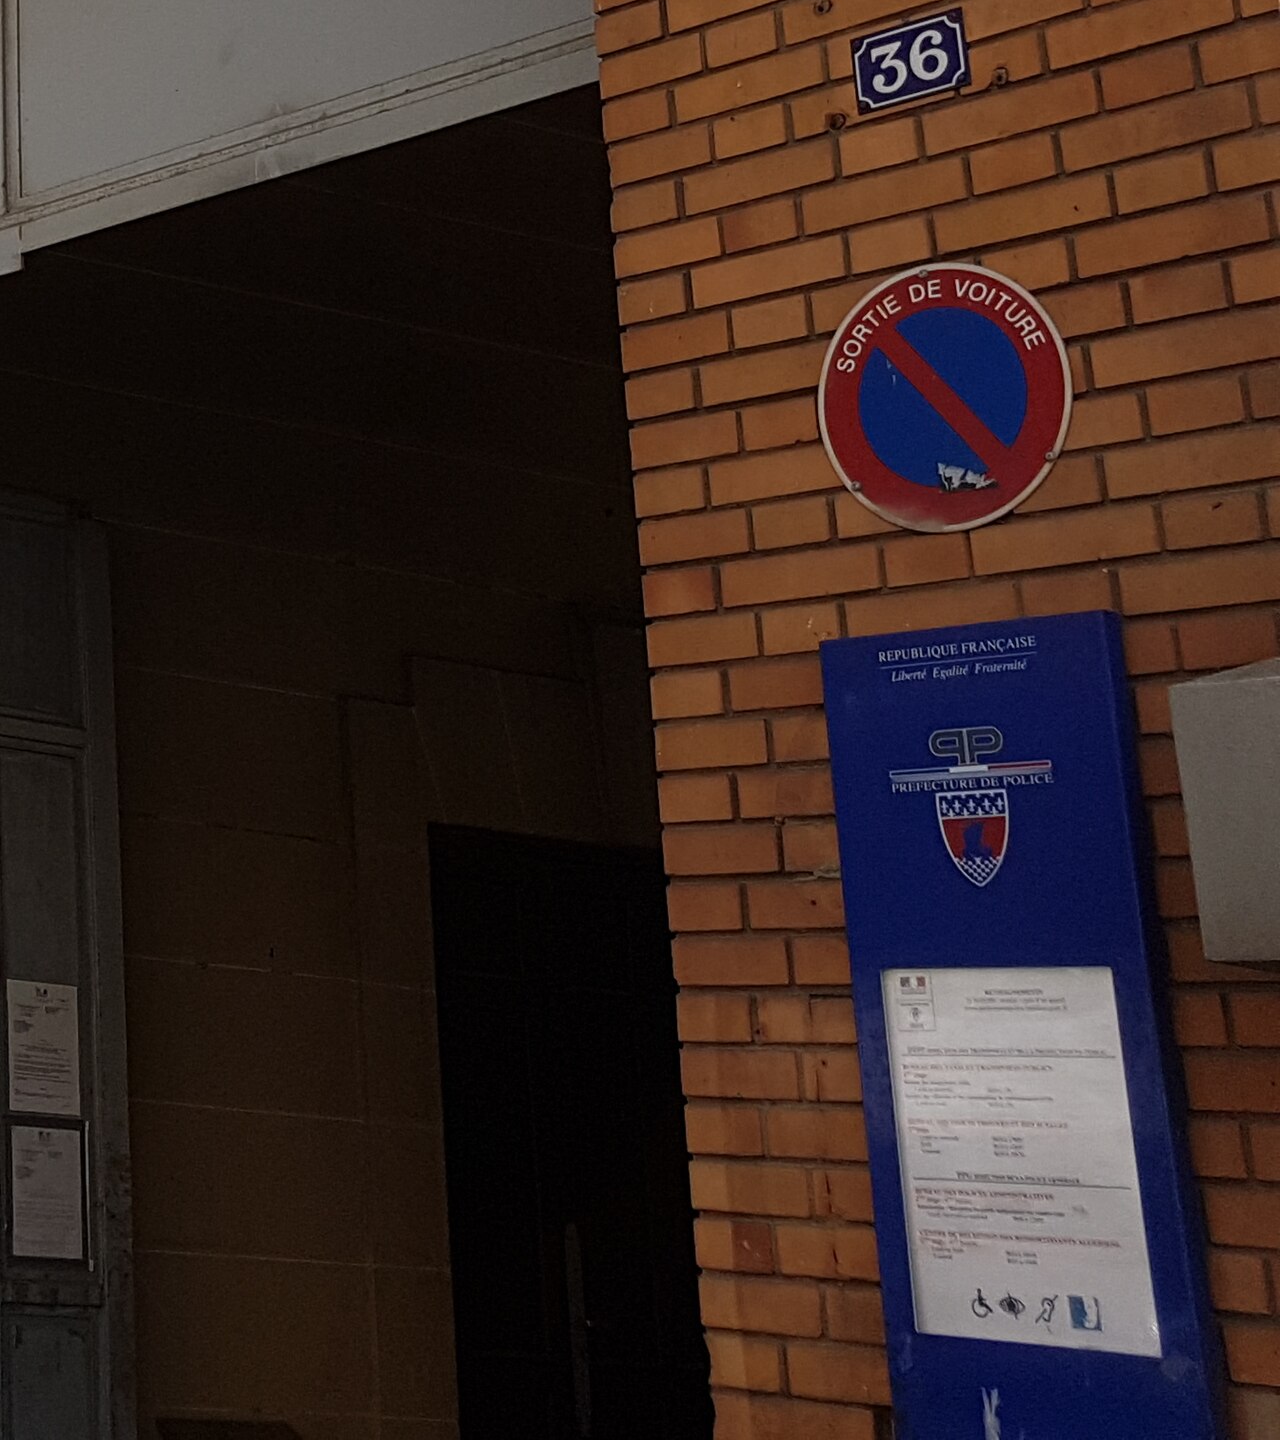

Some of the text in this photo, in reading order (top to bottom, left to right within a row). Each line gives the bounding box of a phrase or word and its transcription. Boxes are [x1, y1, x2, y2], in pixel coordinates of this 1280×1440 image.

[869, 29, 950, 96] 36
[836, 278, 1046, 374] SORTIE DE VOITURE
[961, 635, 1037, 653] FRANÇAISE
[891, 669, 927, 682] Liberté
[974, 658, 1027, 675] Fraternité
[980, 776, 1000, 788] DE
[1003, 773, 1054, 786] POLICE
